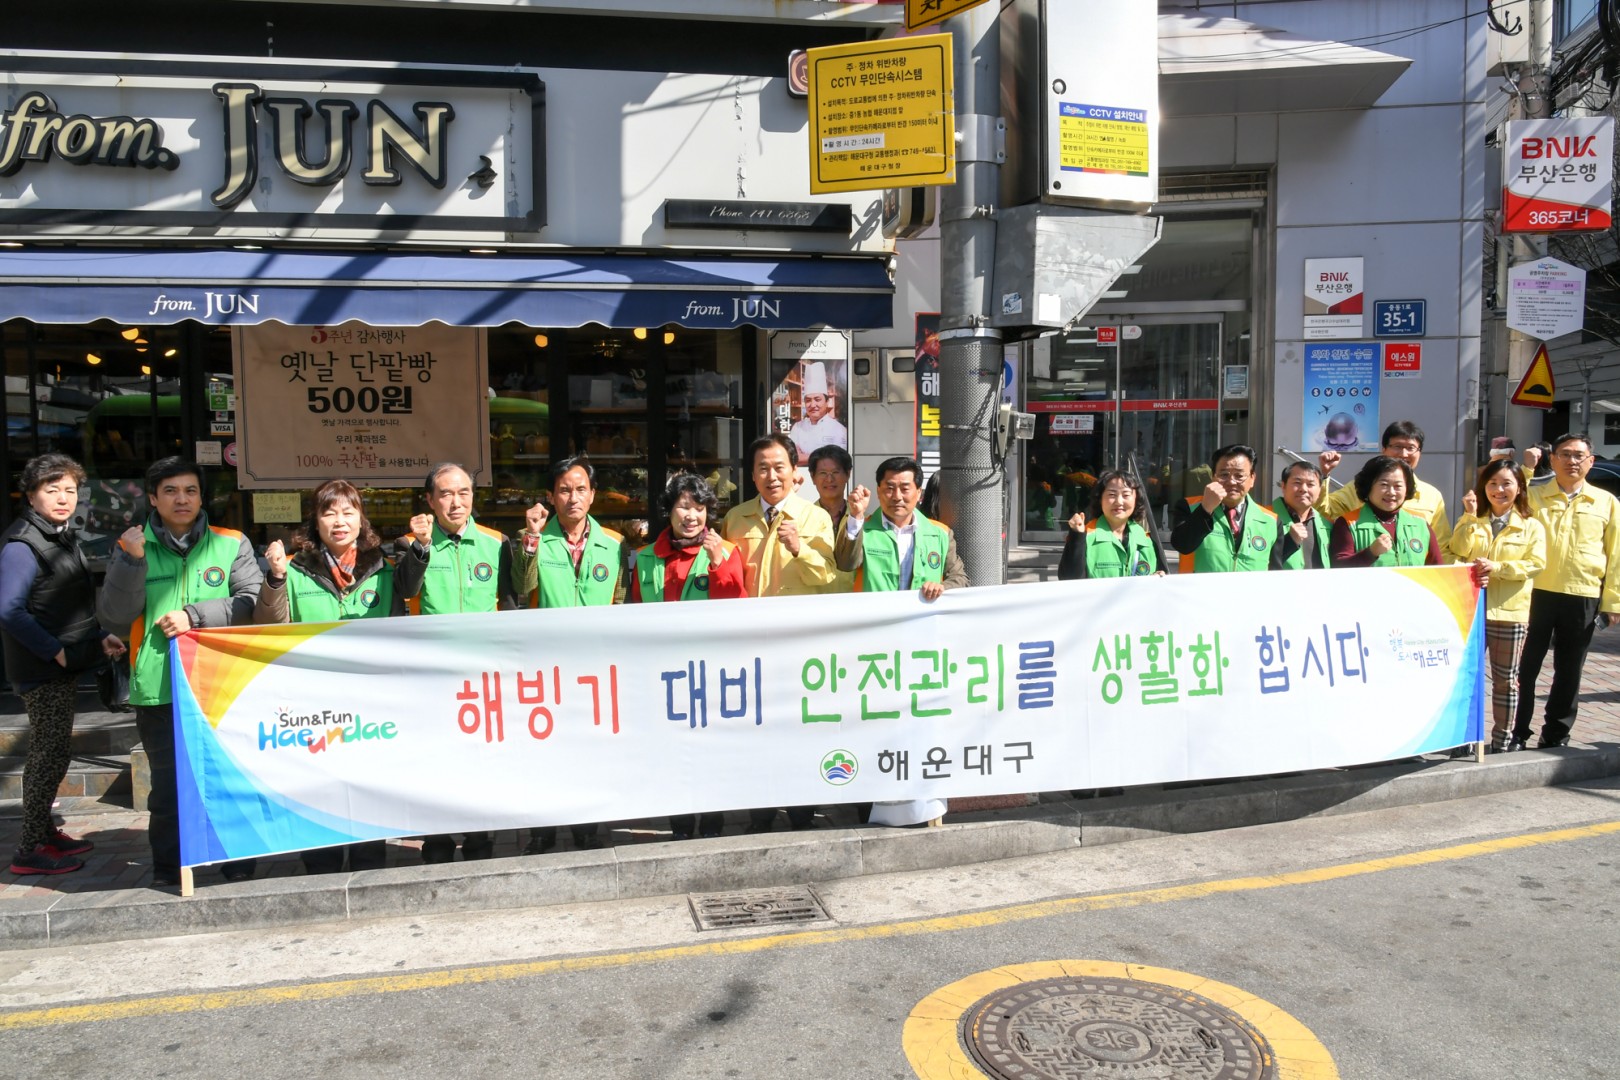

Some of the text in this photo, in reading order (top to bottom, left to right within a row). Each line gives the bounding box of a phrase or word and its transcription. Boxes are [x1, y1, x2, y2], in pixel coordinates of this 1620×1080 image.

[876, 56, 907, 68] 위반차량
[830, 68, 923, 89] CCTV 무인단속시스템
[926, 89, 937, 97] 단속
[1089, 108, 1112, 118] CCTV
[1113, 110, 1144, 121] 설치안내
[0, 82, 456, 208] from. JUN
[861, 137, 881, 146] 24시간
[1521, 134, 1598, 160] BNK
[1517, 164, 1598, 185] 부산은행
[709, 205, 744, 219] Phone
[1528, 207, 1590, 226] 365코너
[1320, 272, 1349, 283] BNK
[1315, 283, 1353, 294] 부산은행
[149, 292, 260, 318] from. JUN
[681, 297, 782, 323] from. JUN
[1382, 312, 1416, 328] 35-1
[310, 325, 407, 345] 5주년 감사행사
[807, 338, 828, 349] JUN
[1390, 352, 1416, 362] 에스원
[280, 350, 438, 383] 옛날 단팥빵
[307, 385, 413, 415] 500원
[336, 418, 365, 427] 가격으로
[335, 434, 387, 445] 우리 제과점은
[296, 455, 334, 469] 100%
[455, 621, 1370, 744] 해빙기 대비 안전관리를 생활화 합시다
[279, 710, 353, 728] Sun&Fun
[258, 714, 399, 755] Haeundae
[877, 740, 1036, 782] 해운대구
